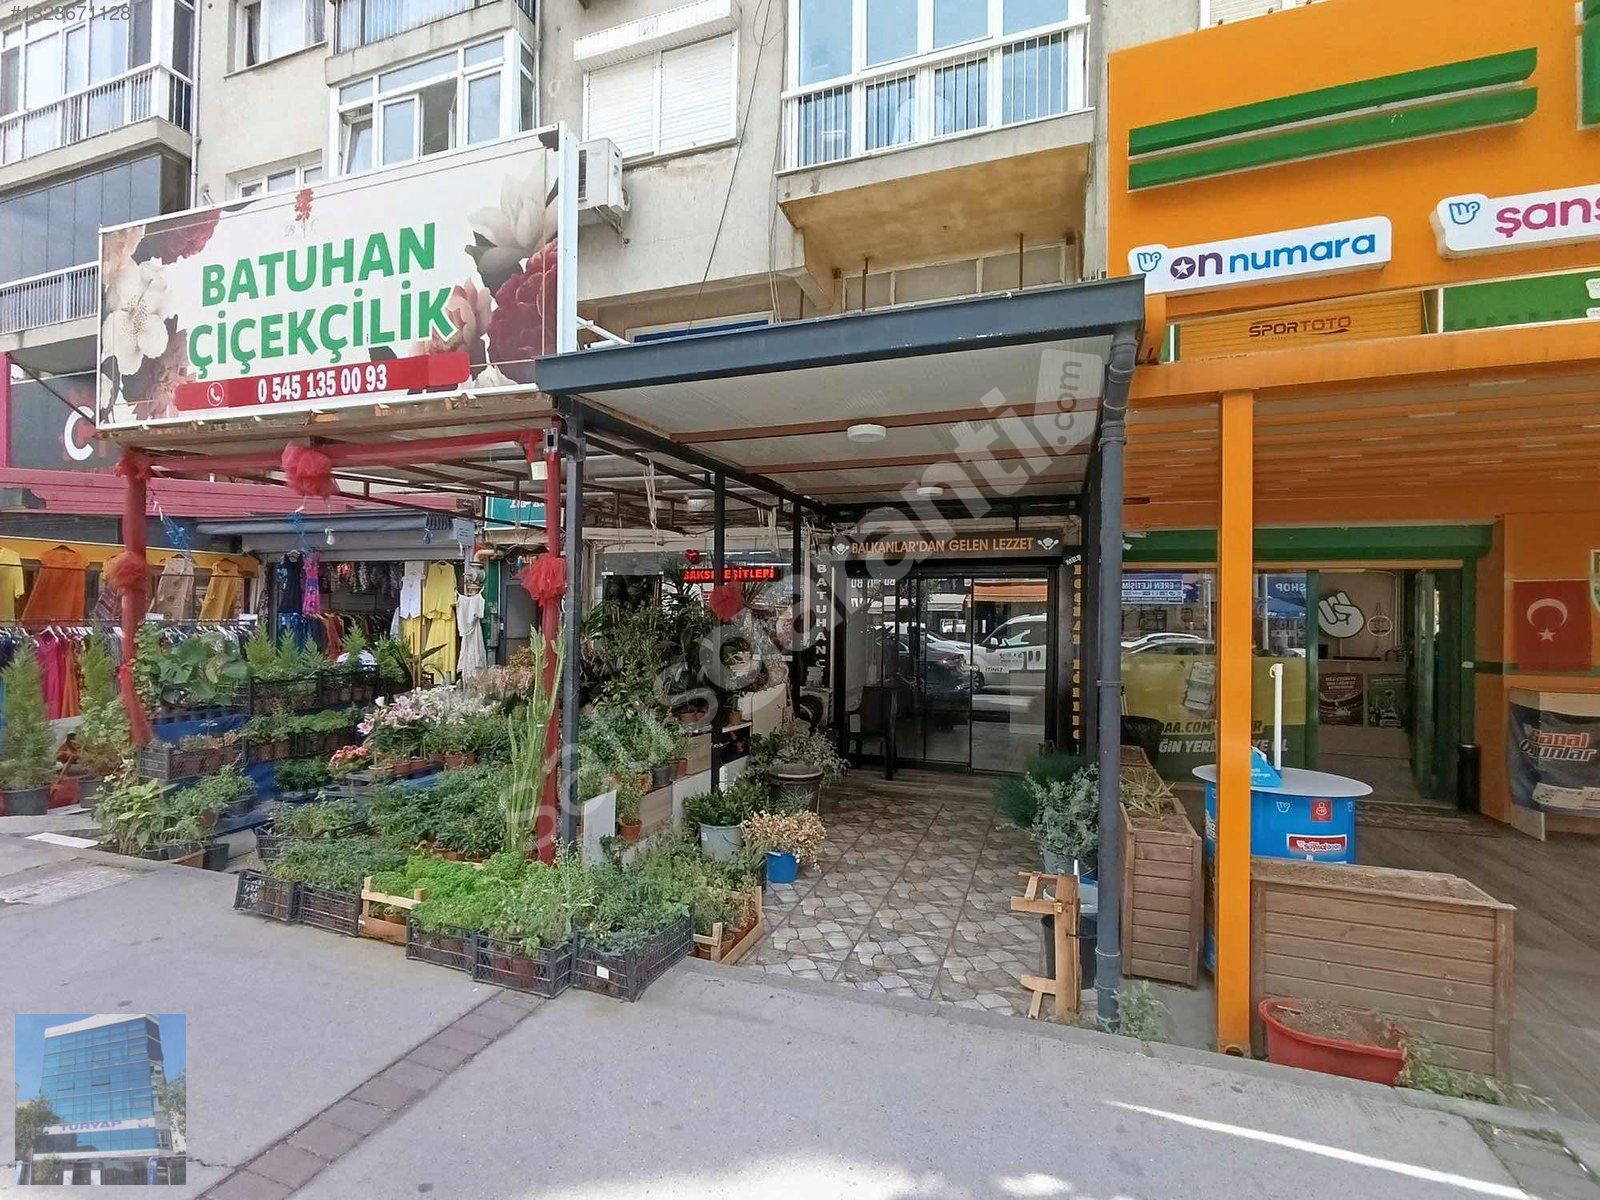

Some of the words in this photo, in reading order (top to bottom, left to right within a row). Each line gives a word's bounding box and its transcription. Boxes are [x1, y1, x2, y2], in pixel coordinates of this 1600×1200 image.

[1495, 197, 1600, 238] şan
[202, 222, 435, 307] BATUHAN
[1170, 252, 1223, 280] on
[1229, 233, 1375, 273] numara
[189, 280, 455, 380] ÇİÇEKÇİLİK
[258, 379, 268, 403] 0
[272, 375, 301, 400] 545
[306, 371, 336, 397] 135
[341, 367, 361, 392] 00
[366, 364, 387, 390] 93
[851, 539, 945, 555] BALKANLAR'DAN
[949, 539, 988, 551] GELEN
[991, 537, 1034, 550] LEZZET
[723, 566, 774, 580] EŞİTLERİ
